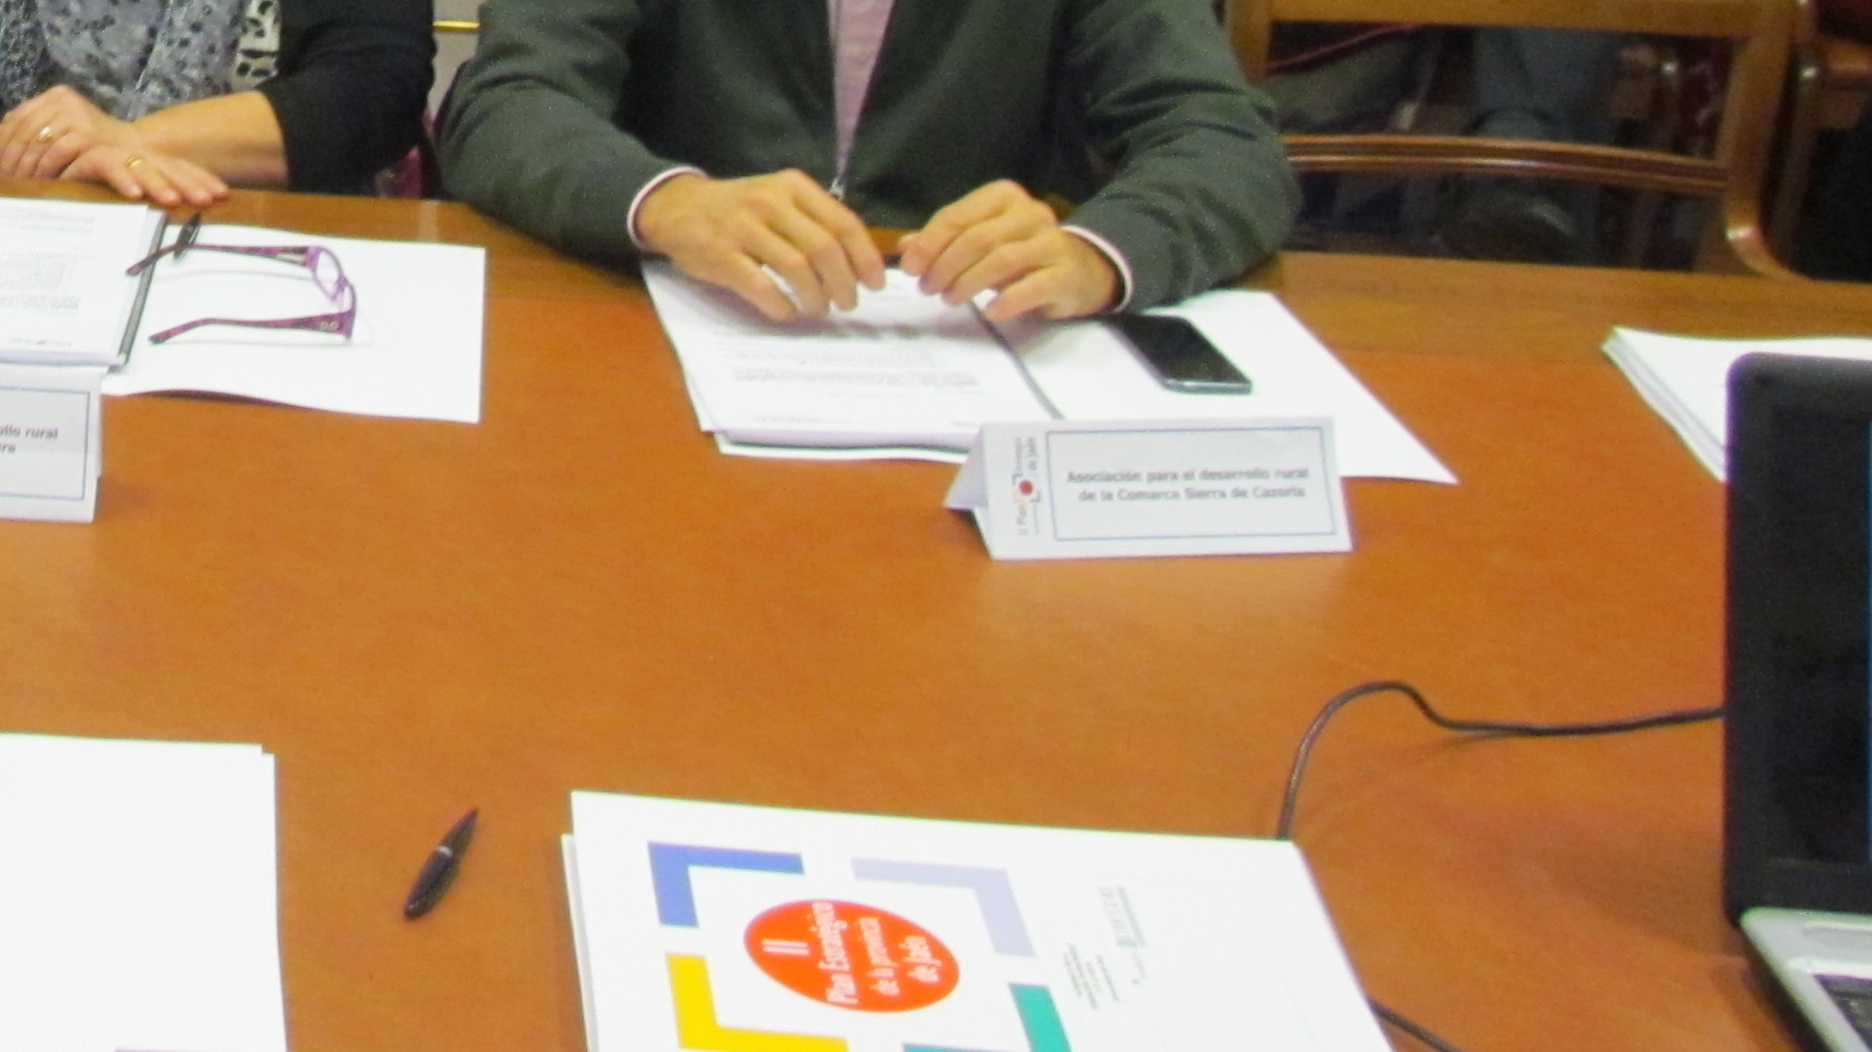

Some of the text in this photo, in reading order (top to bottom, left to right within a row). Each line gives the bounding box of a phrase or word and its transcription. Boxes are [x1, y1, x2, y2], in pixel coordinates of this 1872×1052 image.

[24, 426, 59, 440] rural
[1066, 466, 1310, 485] Asociación para el desarrollo rural
[1078, 489, 1098, 502] de
[1100, 488, 1114, 502] la
[1116, 487, 1180, 502] Comarca
[1183, 485, 1228, 500] Sierra
[1230, 485, 1250, 499] de
[899, 936, 943, 984] de Jaén
[824, 971, 860, 1006] Plan
